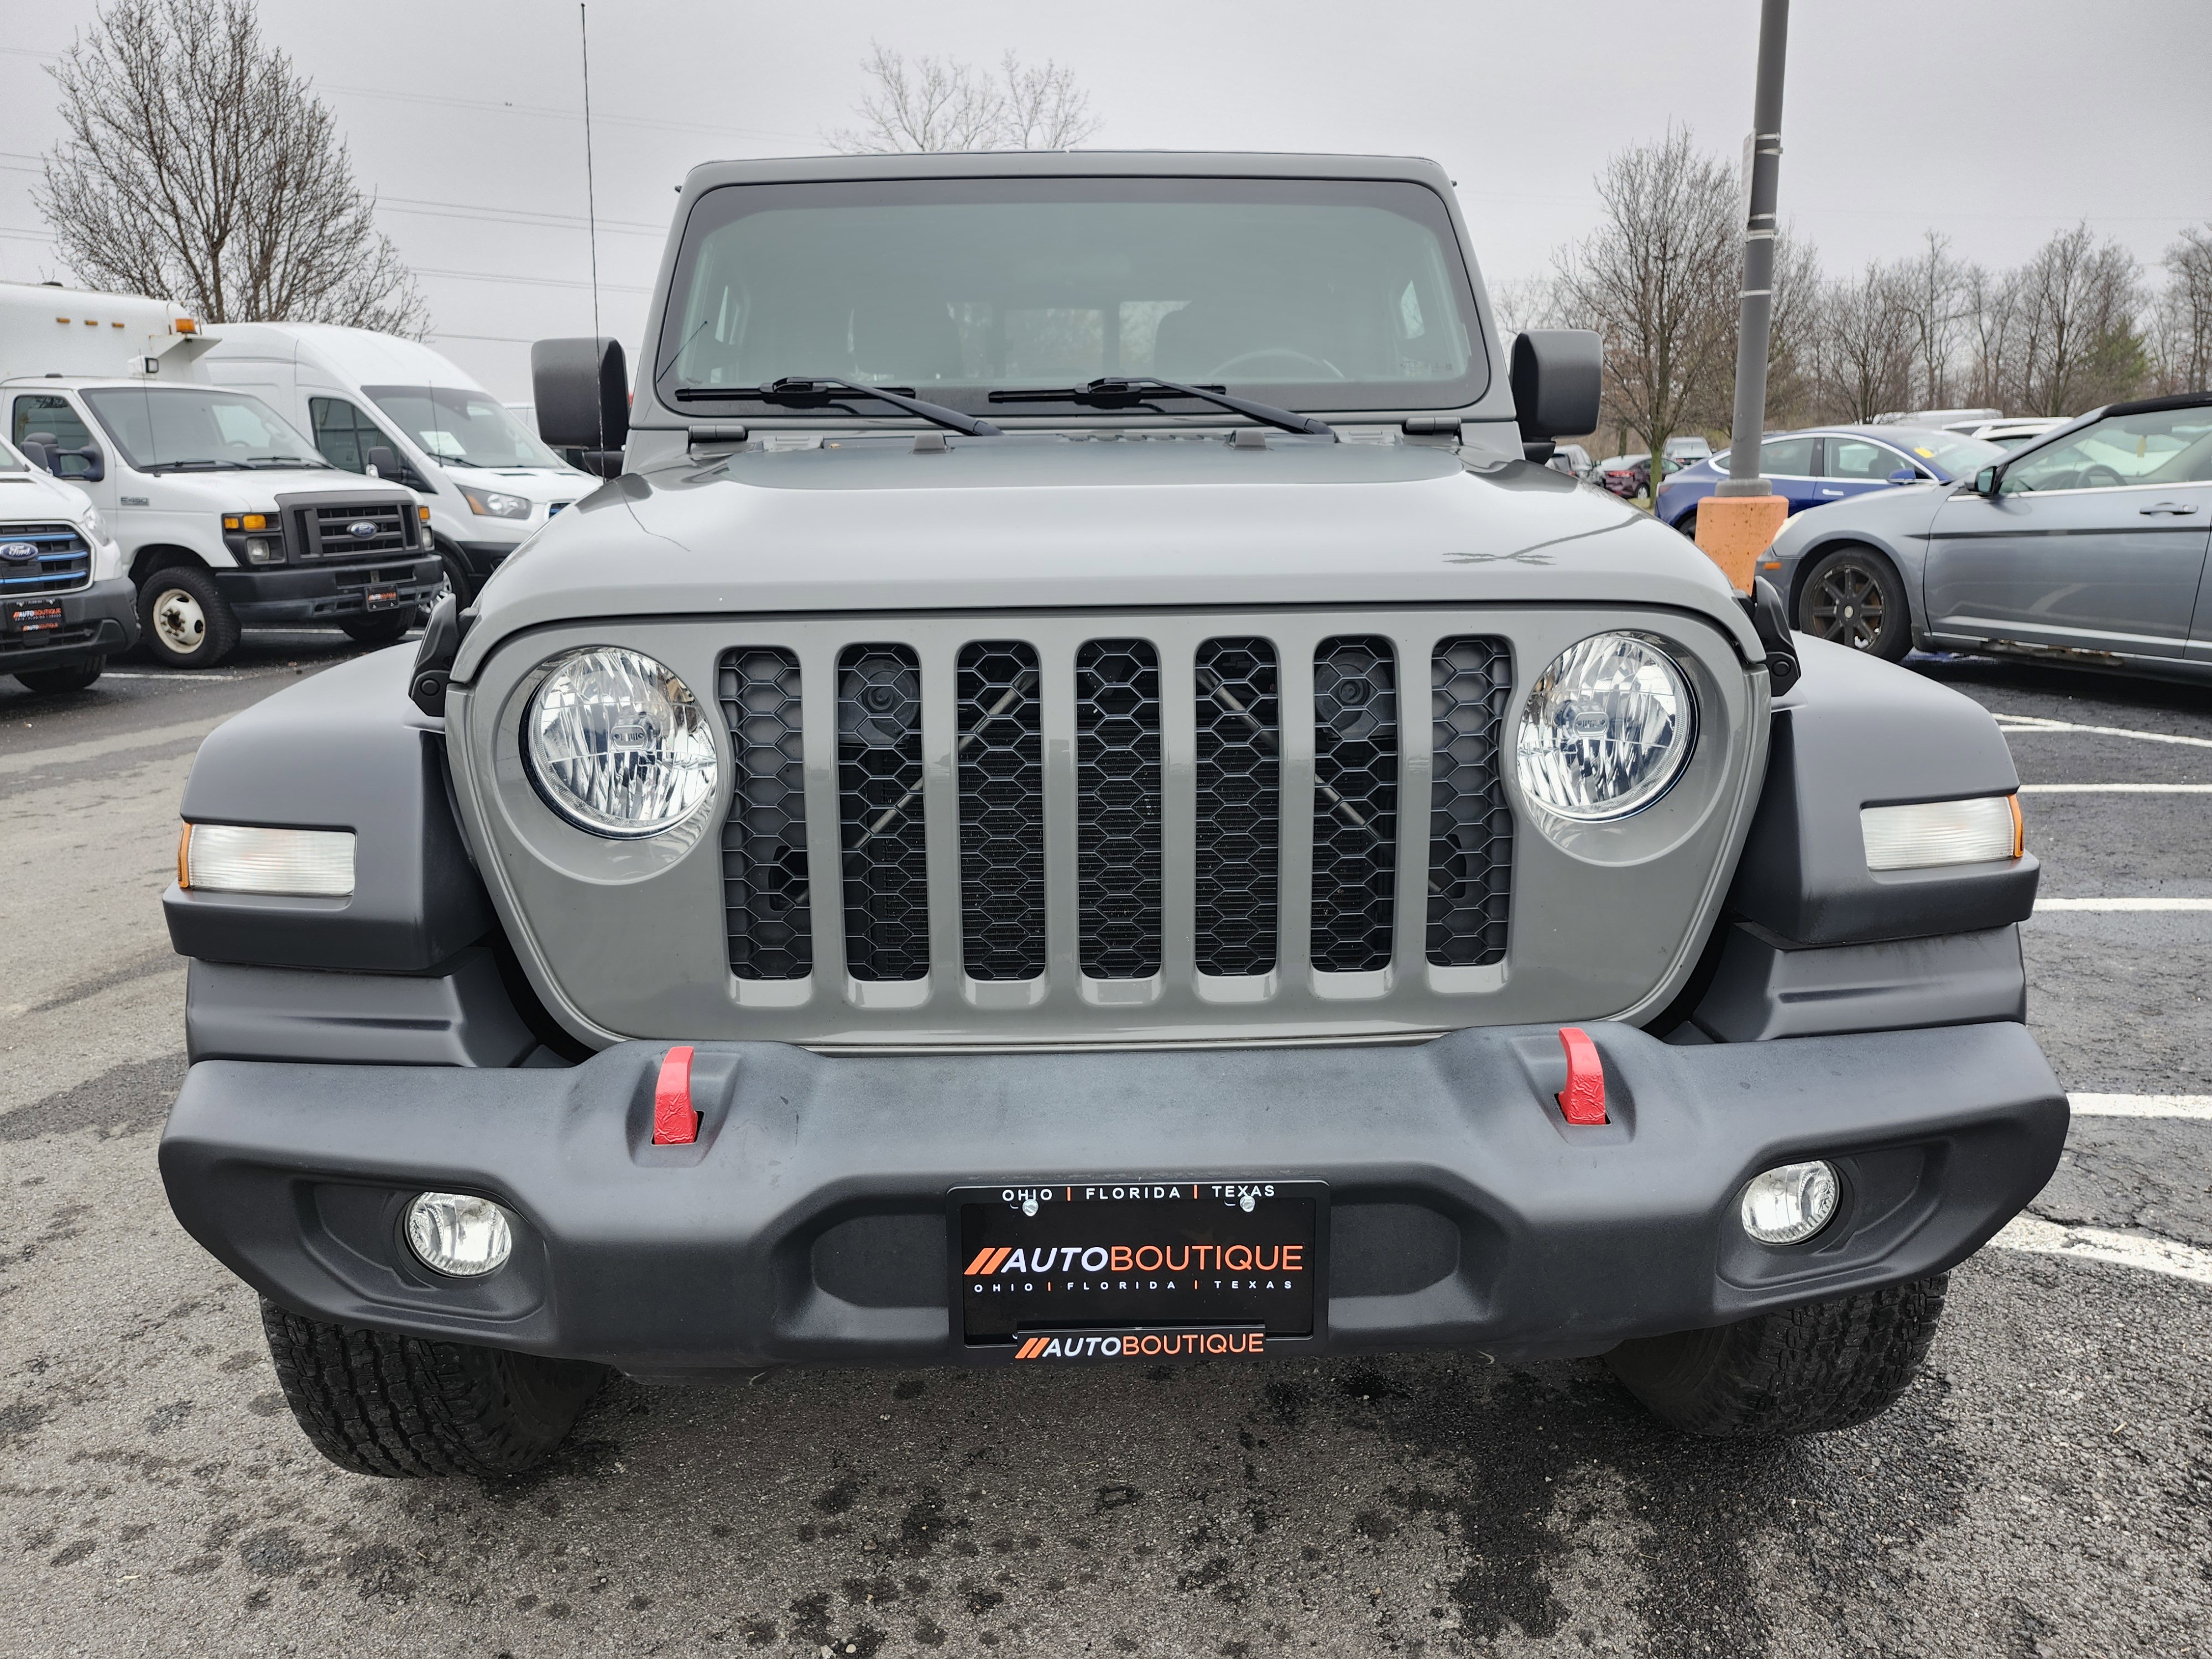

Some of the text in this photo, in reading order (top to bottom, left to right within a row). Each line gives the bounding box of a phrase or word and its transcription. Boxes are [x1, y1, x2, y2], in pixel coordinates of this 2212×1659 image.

[9, 545, 30, 556] Ford
[1002, 1185, 1275, 1202] OHIO FLORIDA TEXAS
[974, 1280, 1292, 1293] OHIO FLORIDA TEXAS
